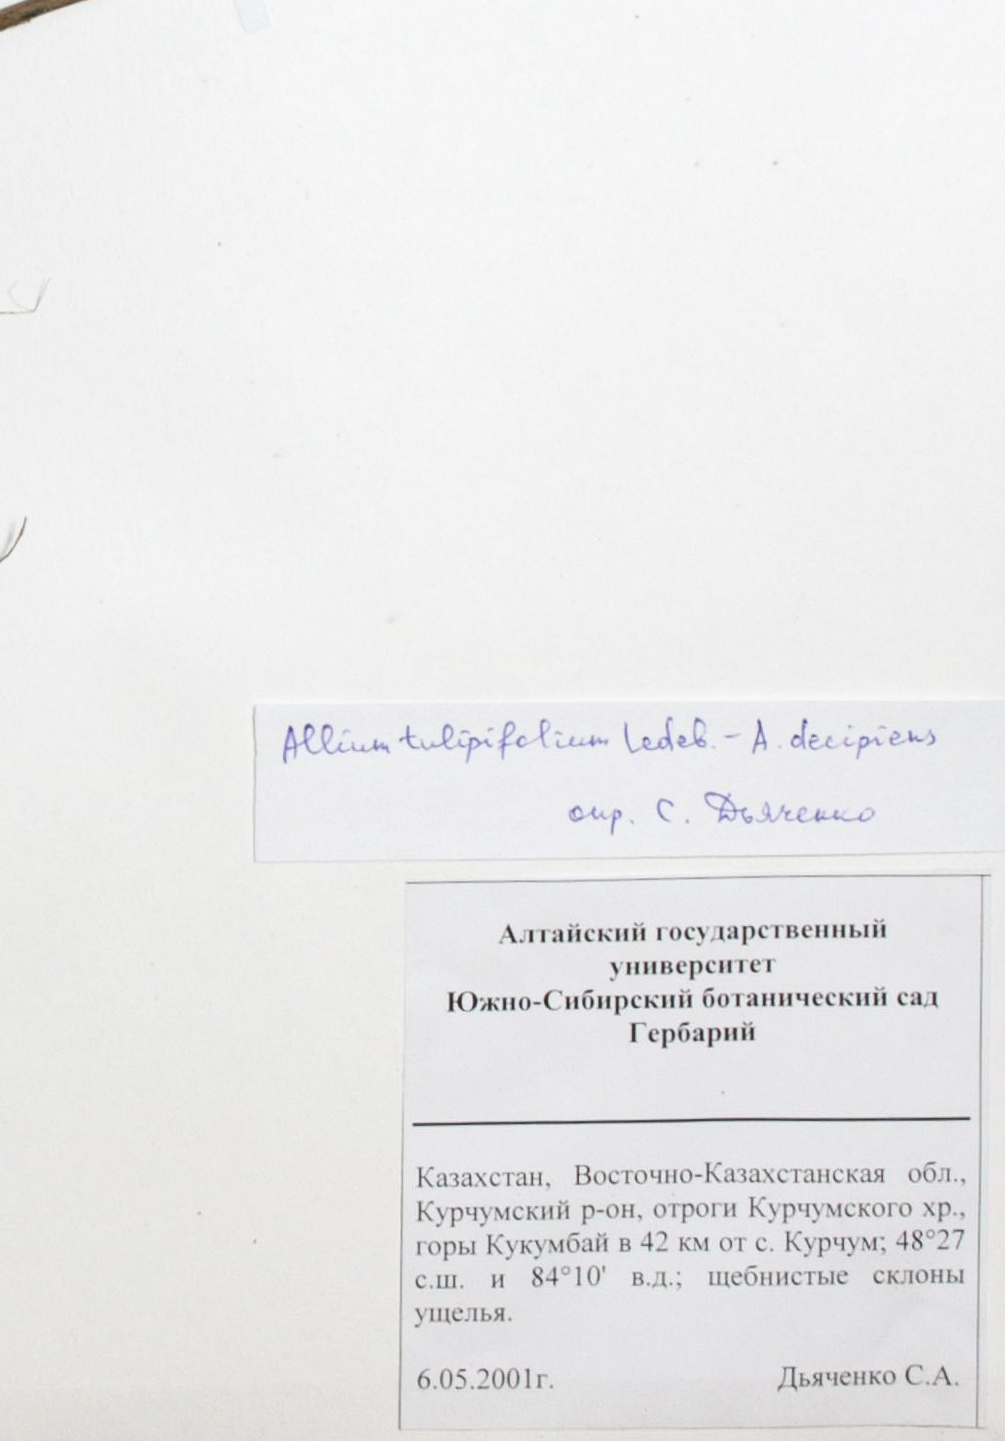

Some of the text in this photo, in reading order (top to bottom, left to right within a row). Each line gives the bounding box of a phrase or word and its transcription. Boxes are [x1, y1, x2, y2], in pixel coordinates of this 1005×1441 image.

[283, 723, 391, 764] Allium
[790, 718, 936, 760] decipiens
[499, 918, 886, 947] Алтайский государственный
[609, 958, 776, 982] университет
[447, 986, 939, 1016] Южно-Сибирский ботанический сад
[629, 1021, 755, 1049] Гербарий
[417, 1161, 966, 1190] Казахстан, Восточно-Казахстанская обл.,
[417, 1196, 965, 1228] Курчумский р-он, отроги Курчумского хр.,
[416, 1229, 965, 1261] горы Кукумбай в 42 км от с. Курчум; 48°27
[415, 1265, 964, 1289] с.ш. и 84°10' в.д.; щебнистые склоны
[415, 1307, 512, 1328] ущелья.
[417, 1364, 959, 1392] 6.05.2001г. Дьяченко С.А.
